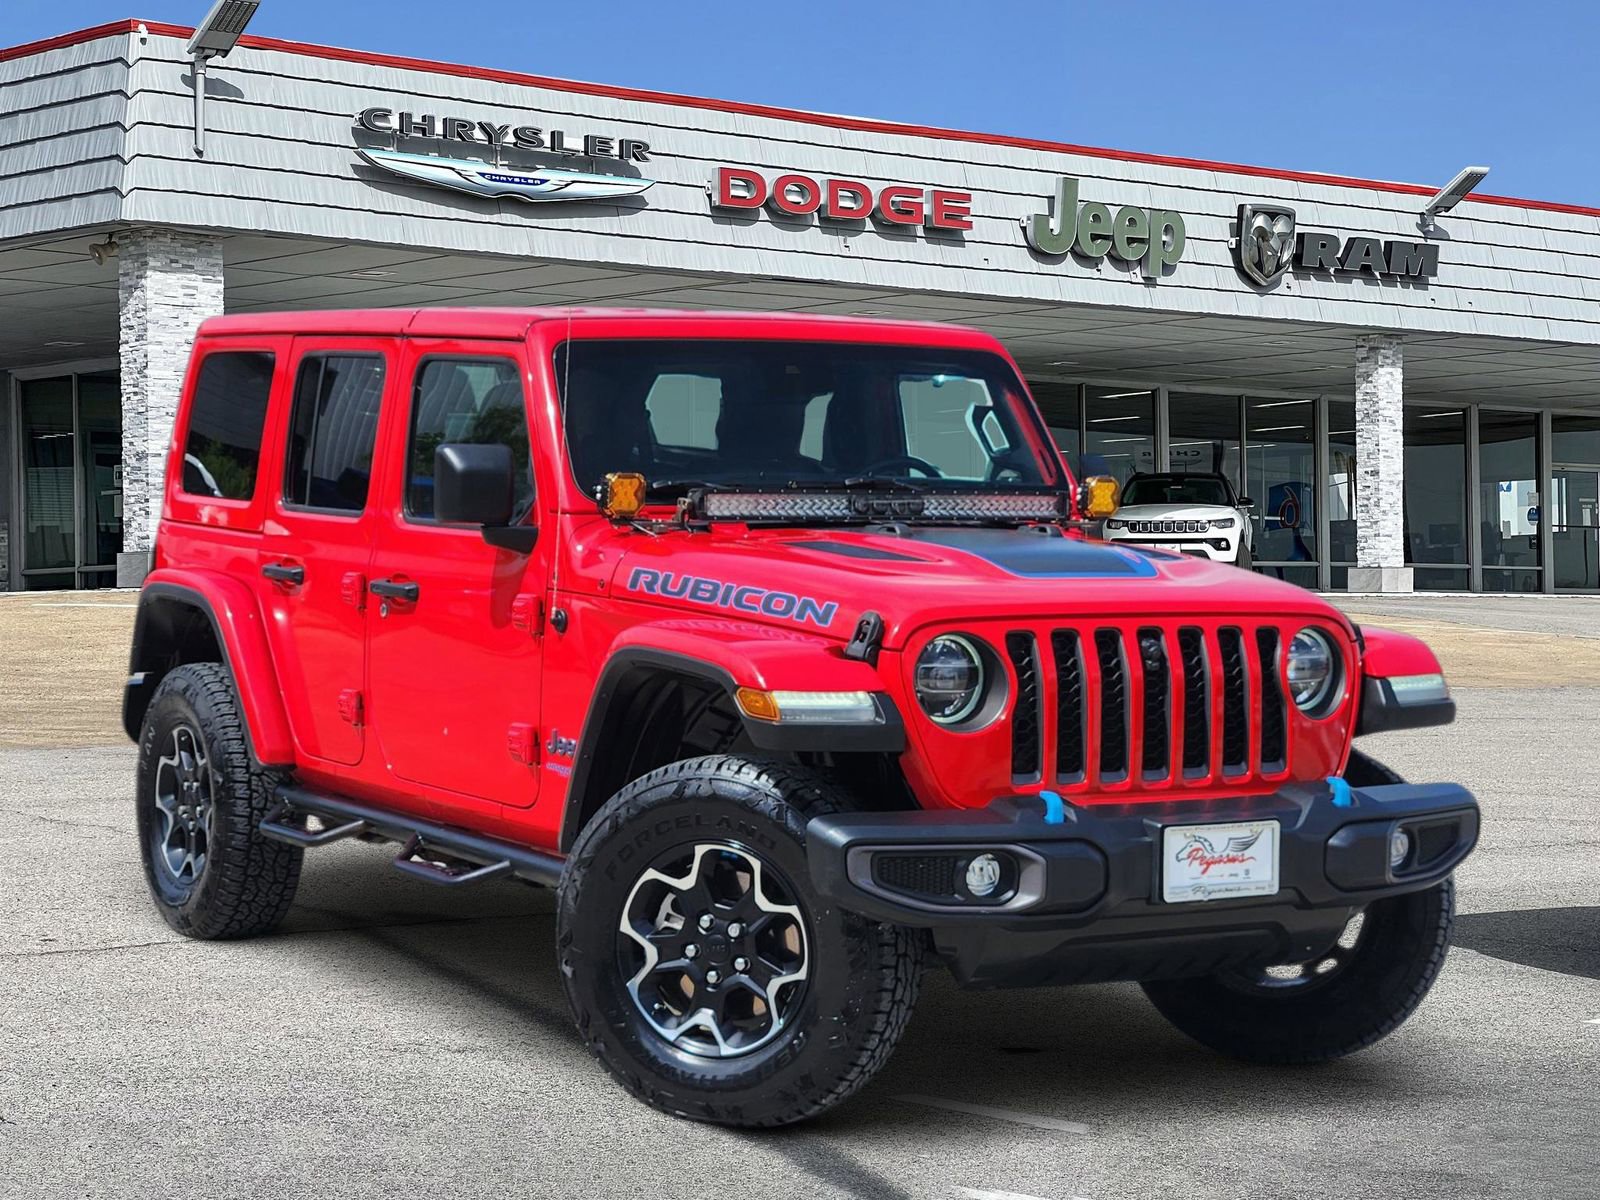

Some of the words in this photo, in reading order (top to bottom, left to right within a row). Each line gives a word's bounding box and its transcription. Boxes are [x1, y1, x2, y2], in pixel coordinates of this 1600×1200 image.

[359, 107, 650, 162] CHRYSLER
[484, 174, 541, 185] CHRYSLER
[712, 167, 973, 231] DODGE
[1027, 177, 1186, 278] Jeep
[1297, 232, 1439, 277] RAM
[627, 567, 838, 628] RUBICON
[546, 728, 577, 757] Jee
[605, 813, 777, 880] FORCELAND
